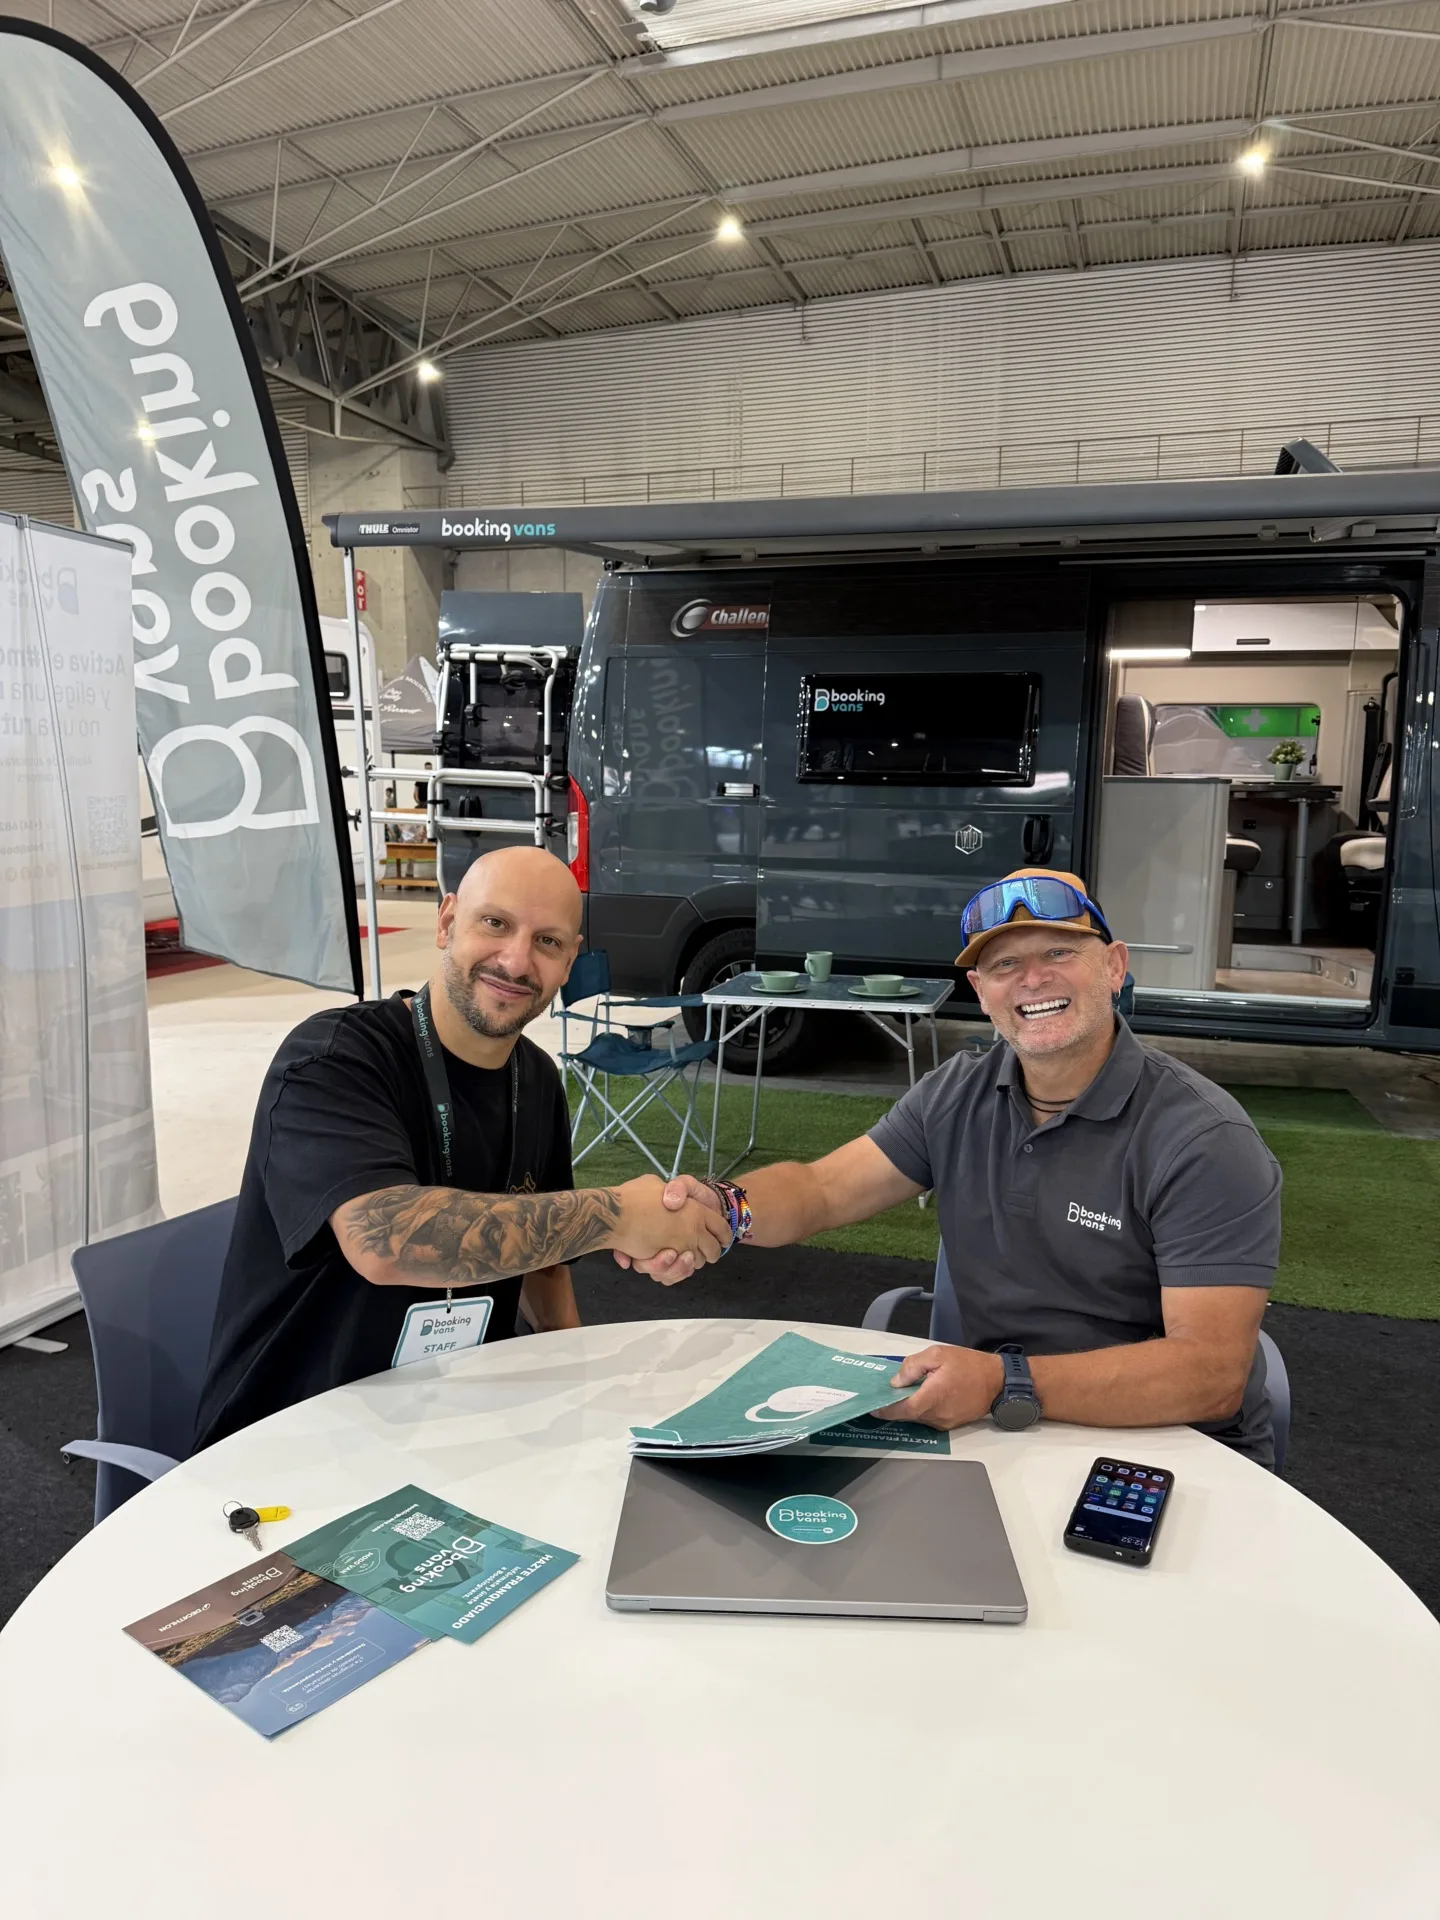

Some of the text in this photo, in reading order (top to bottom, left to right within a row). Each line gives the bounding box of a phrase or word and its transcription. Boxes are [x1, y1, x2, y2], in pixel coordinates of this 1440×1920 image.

[359, 523, 389, 535] THULE
[441, 517, 511, 542] booking
[831, 687, 885, 706] booking
[831, 703, 864, 712] vans
[1079, 1217, 1106, 1232] vans
[1080, 1205, 1122, 1231] booking
[434, 1316, 472, 1328] booking
[433, 1327, 455, 1335] vans
[423, 1341, 457, 1354] STAFF
[796, 1509, 847, 1520] booking
[414, 1548, 453, 1574] vans
[241, 1573, 265, 1586] vans
[399, 1552, 469, 1593] booking
[231, 1575, 271, 1596] booking
[451, 1554, 553, 1629] HAZTE FRANQUICIADO
[159, 1608, 202, 1632] DECATHLON
